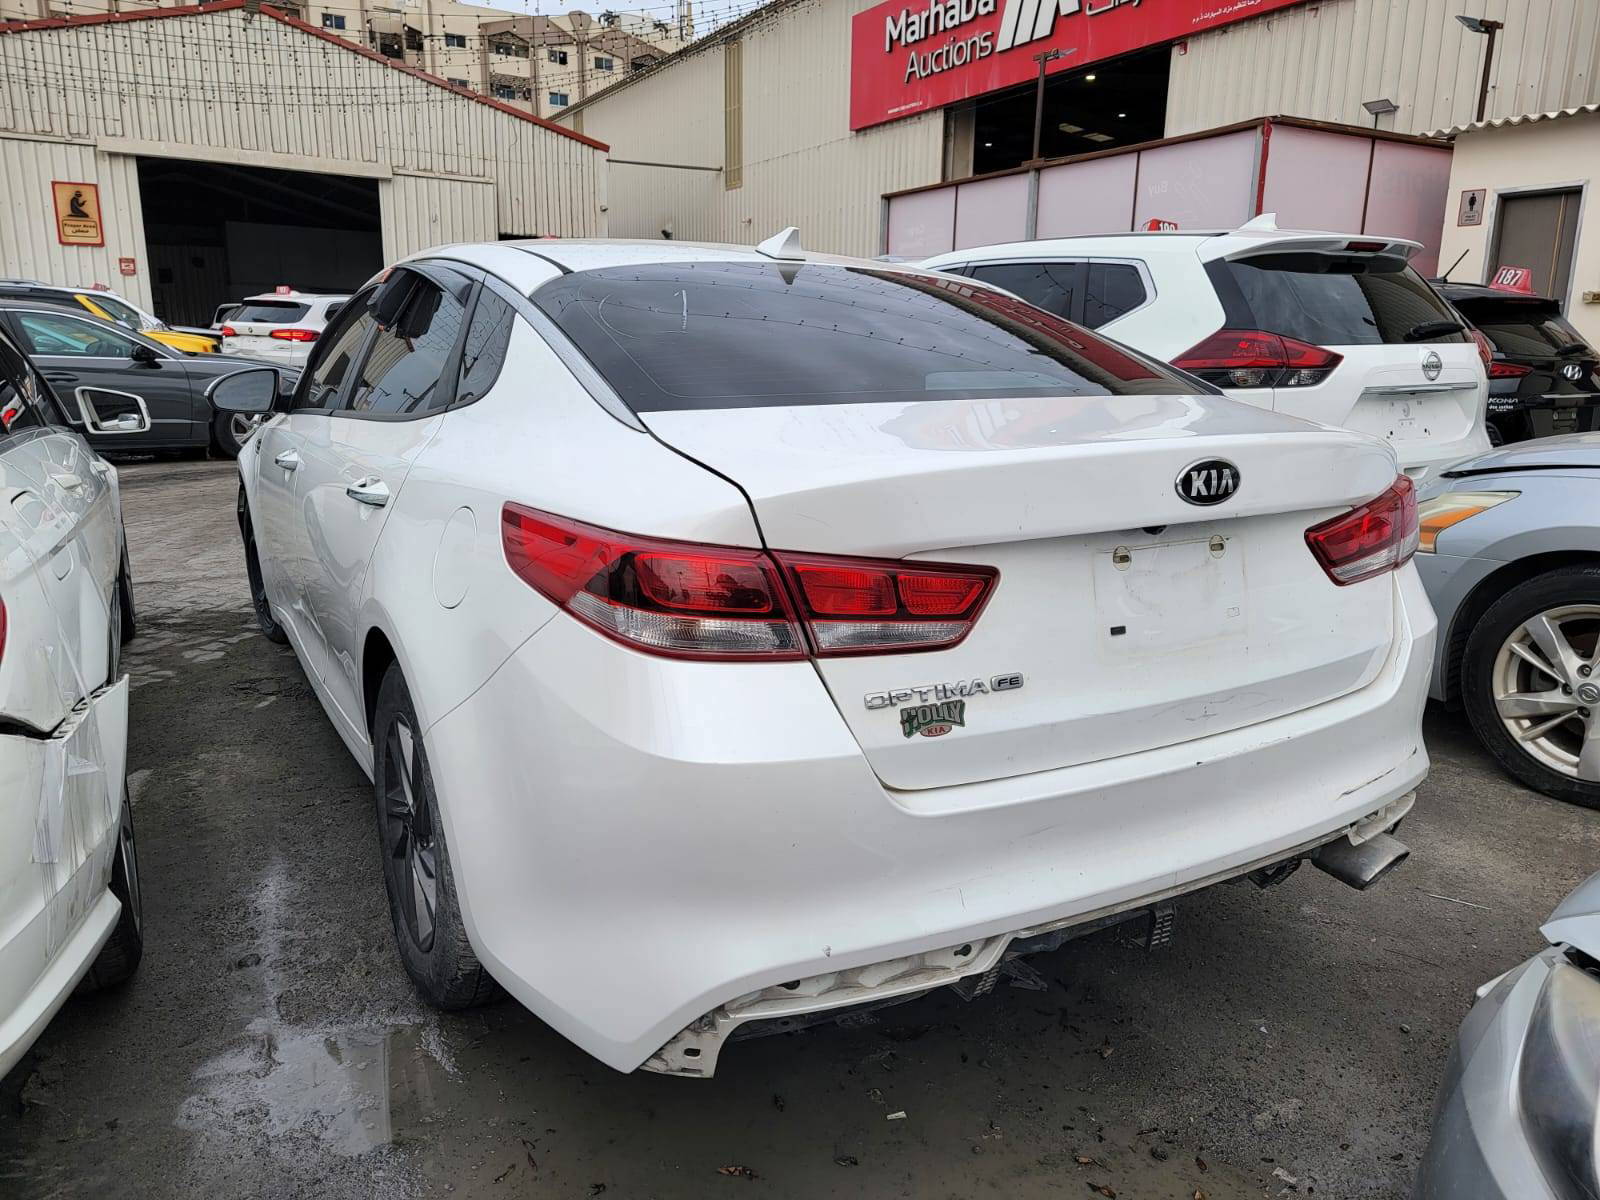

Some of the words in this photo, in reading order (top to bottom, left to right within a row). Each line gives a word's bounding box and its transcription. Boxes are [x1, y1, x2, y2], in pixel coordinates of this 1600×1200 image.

[904, 31, 993, 84] Auctions
[1496, 268, 1523, 286] 187
[1488, 396, 1519, 404] KONA
[1189, 468, 1234, 497] KIA
[864, 678, 990, 710] OPTIMA
[997, 676, 1020, 688] FE
[901, 700, 963, 735] HOLLY
[927, 727, 946, 736] KIA
